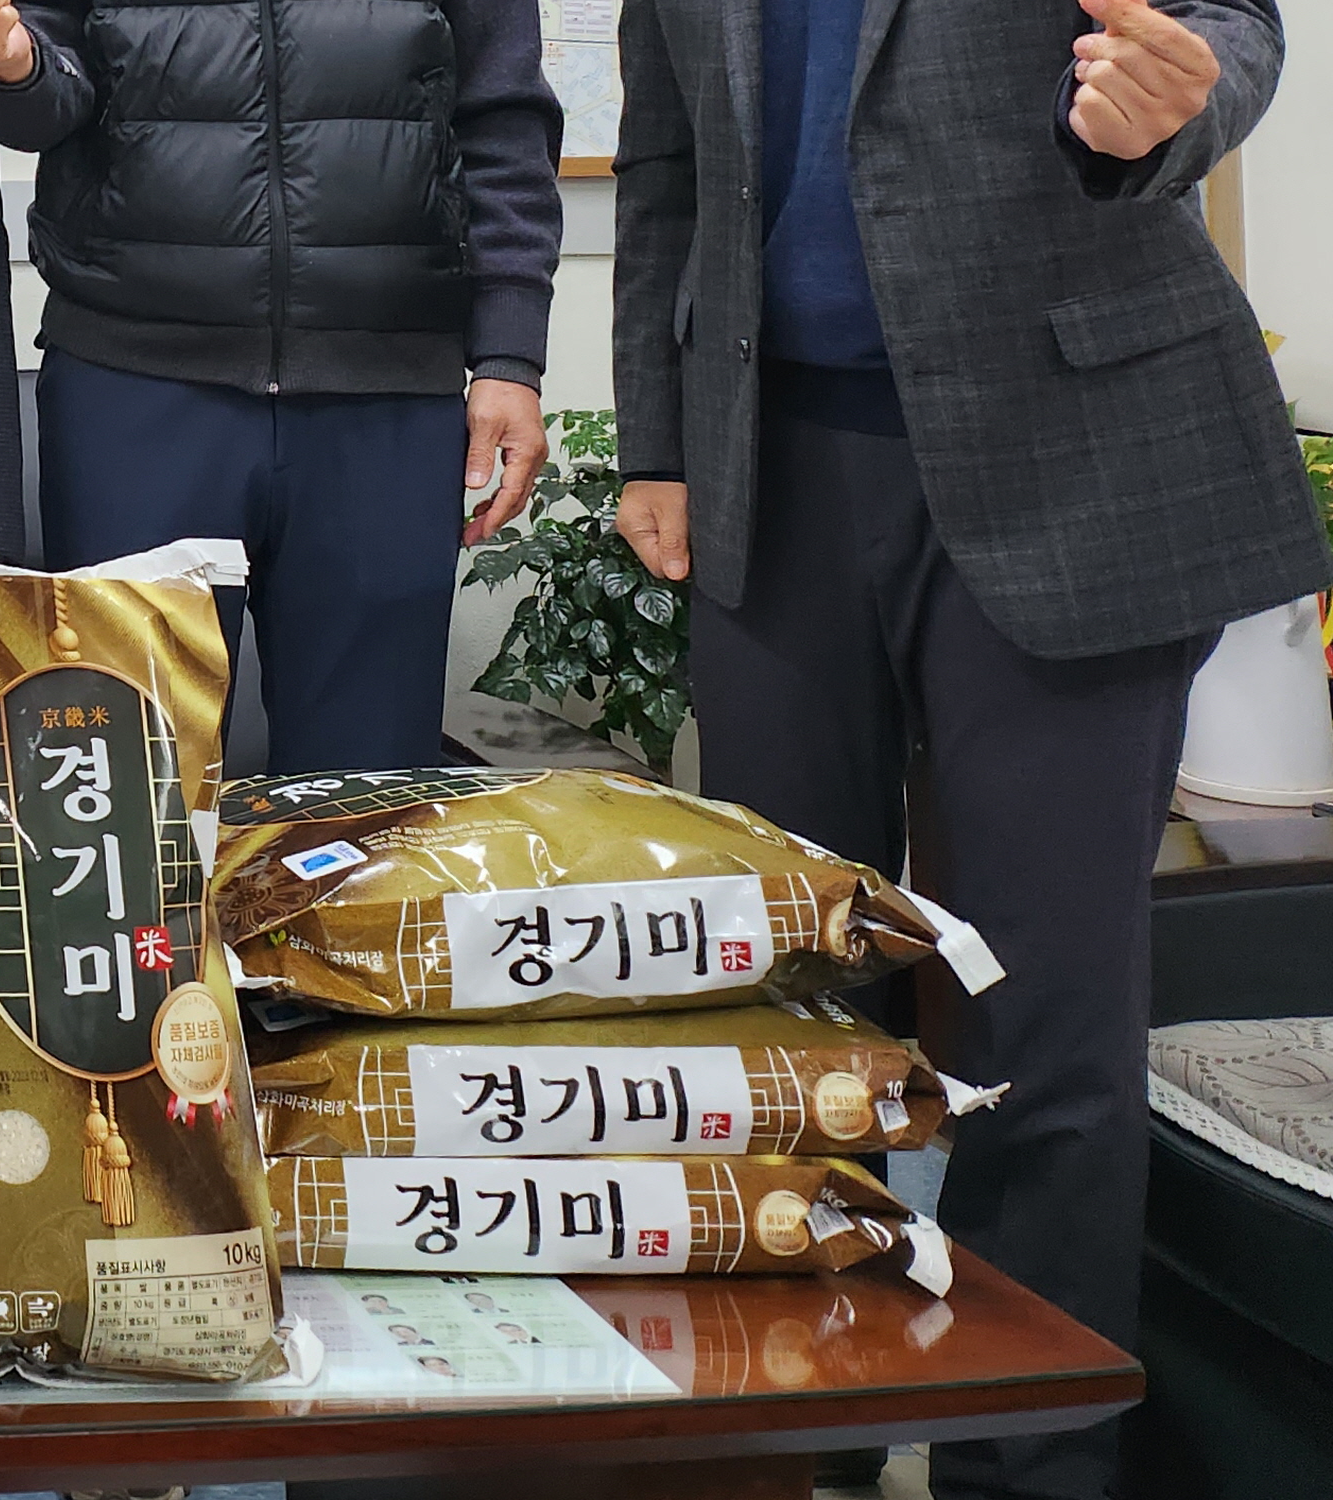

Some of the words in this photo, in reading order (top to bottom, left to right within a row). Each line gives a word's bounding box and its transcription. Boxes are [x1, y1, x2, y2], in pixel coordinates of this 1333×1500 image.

[38, 736, 135, 1022] 경기미
[136, 927, 175, 968] 米
[491, 897, 709, 987] 경기미
[720, 941, 753, 972] 米
[170, 1020, 221, 1042] 품질보증
[256, 1090, 346, 1116] 삼화미곡처리장
[460, 1065, 690, 1143] 경기미
[701, 1112, 732, 1140] 米
[395, 1176, 624, 1258] 경기미
[638, 1230, 669, 1258] 米
[96, 1260, 167, 1276] 품질표시사항
